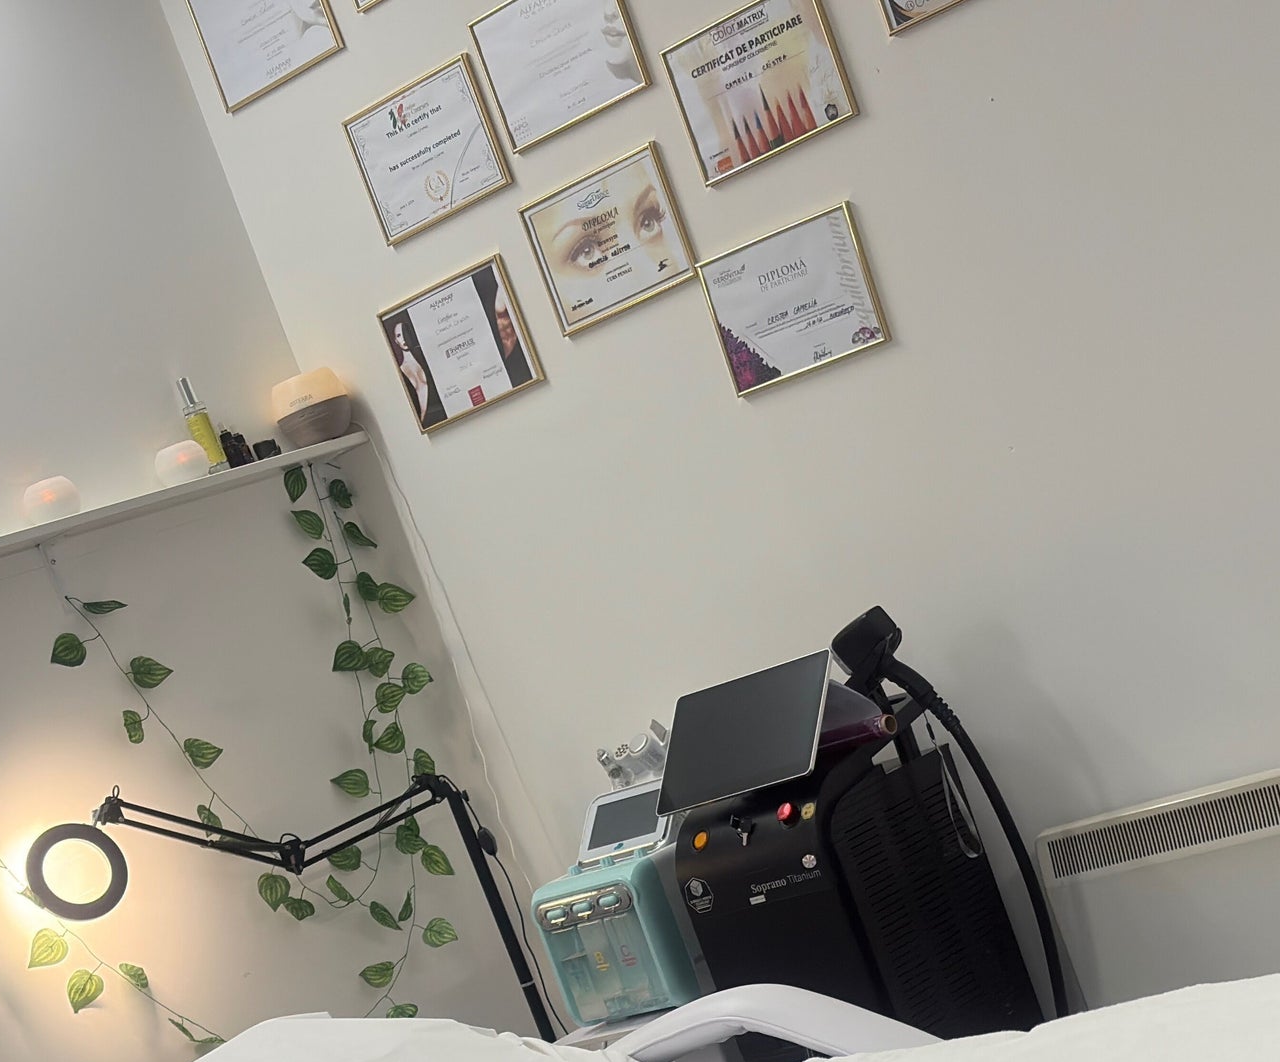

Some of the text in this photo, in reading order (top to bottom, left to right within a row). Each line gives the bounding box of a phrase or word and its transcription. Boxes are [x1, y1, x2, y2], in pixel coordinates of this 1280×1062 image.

[691, 49, 736, 79] CERTIFICAT
[736, 43, 748, 57] DE
[747, 14, 803, 50] PARTICIPARE
[386, 126, 399, 139] This
[411, 111, 430, 127] certify
[430, 104, 442, 116] that
[389, 163, 400, 173] has
[399, 145, 432, 168] successfully
[432, 129, 461, 150] completed
[582, 207, 620, 232] DIPLOMA
[750, 868, 822, 894] Soprano Titanium
